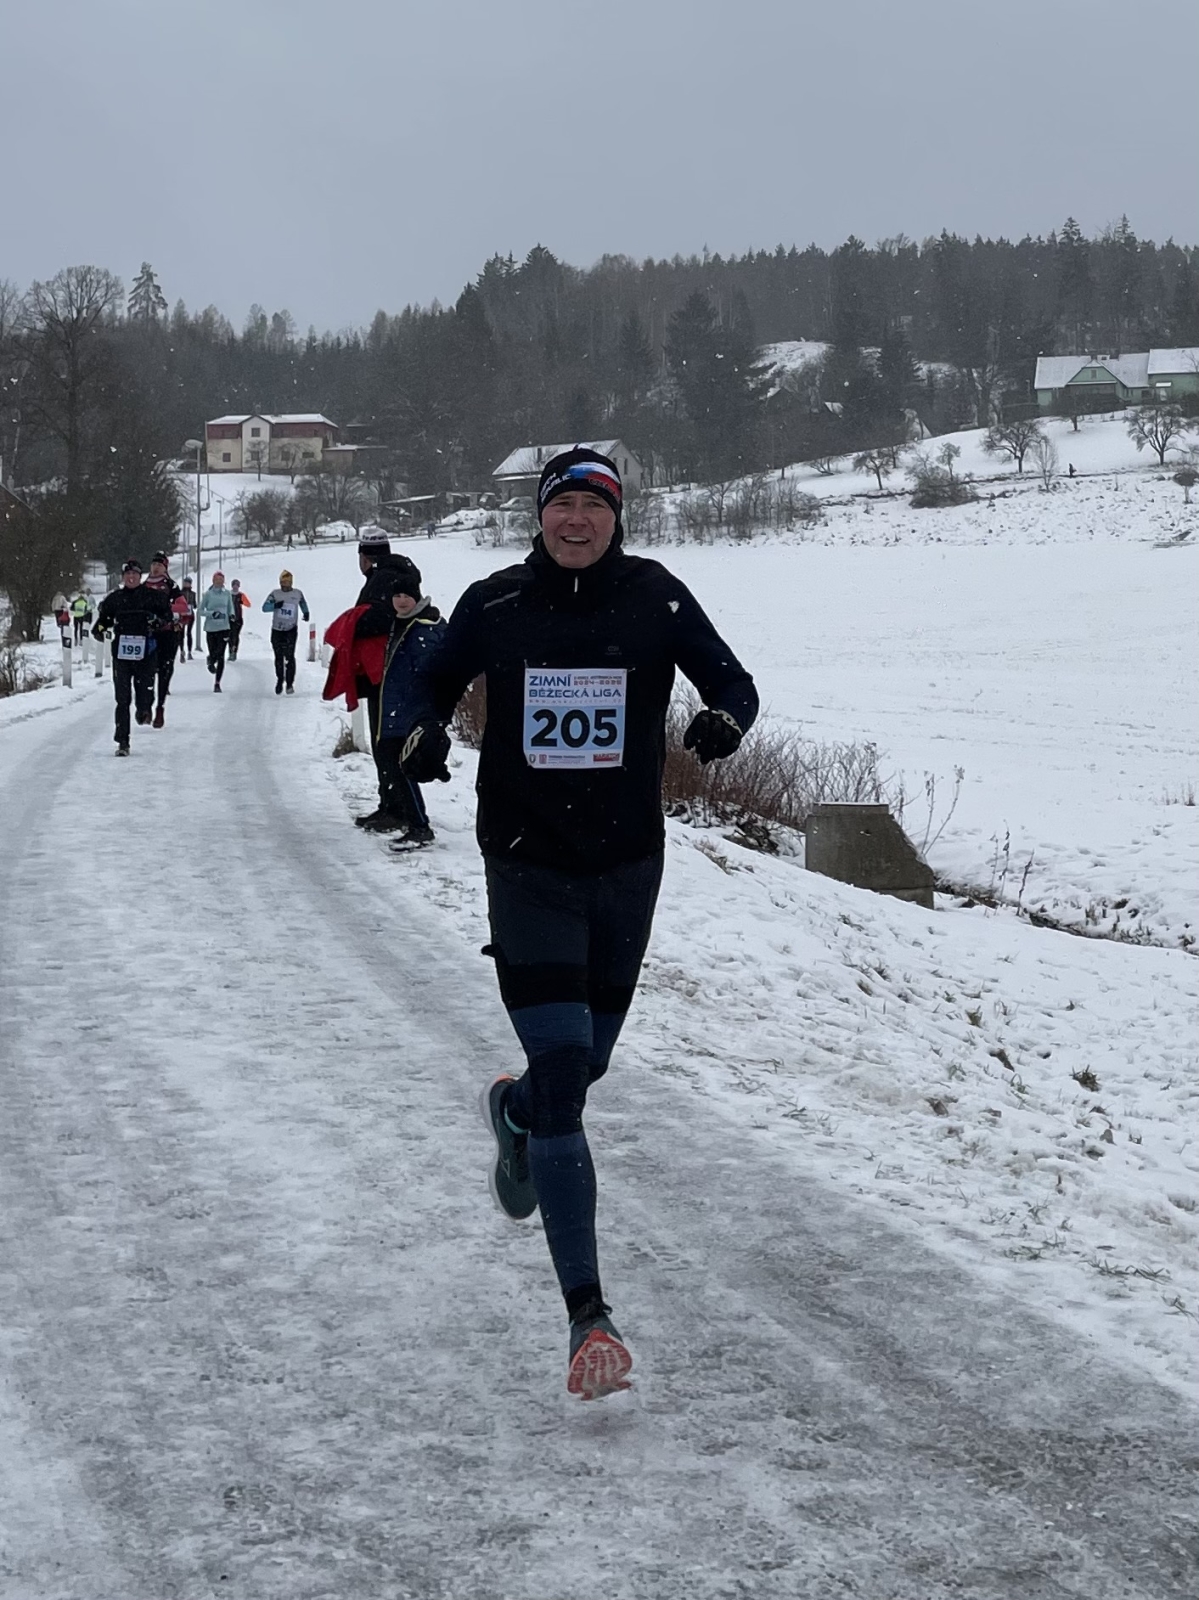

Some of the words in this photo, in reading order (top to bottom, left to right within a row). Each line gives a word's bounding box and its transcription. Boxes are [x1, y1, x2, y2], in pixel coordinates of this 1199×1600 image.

[121, 644, 142, 656] 199
[529, 674, 572, 687] ZIMNÍ
[529, 687, 590, 698] BĚŽECKÁ
[593, 688, 622, 698] LIGA
[530, 708, 618, 749] 205
